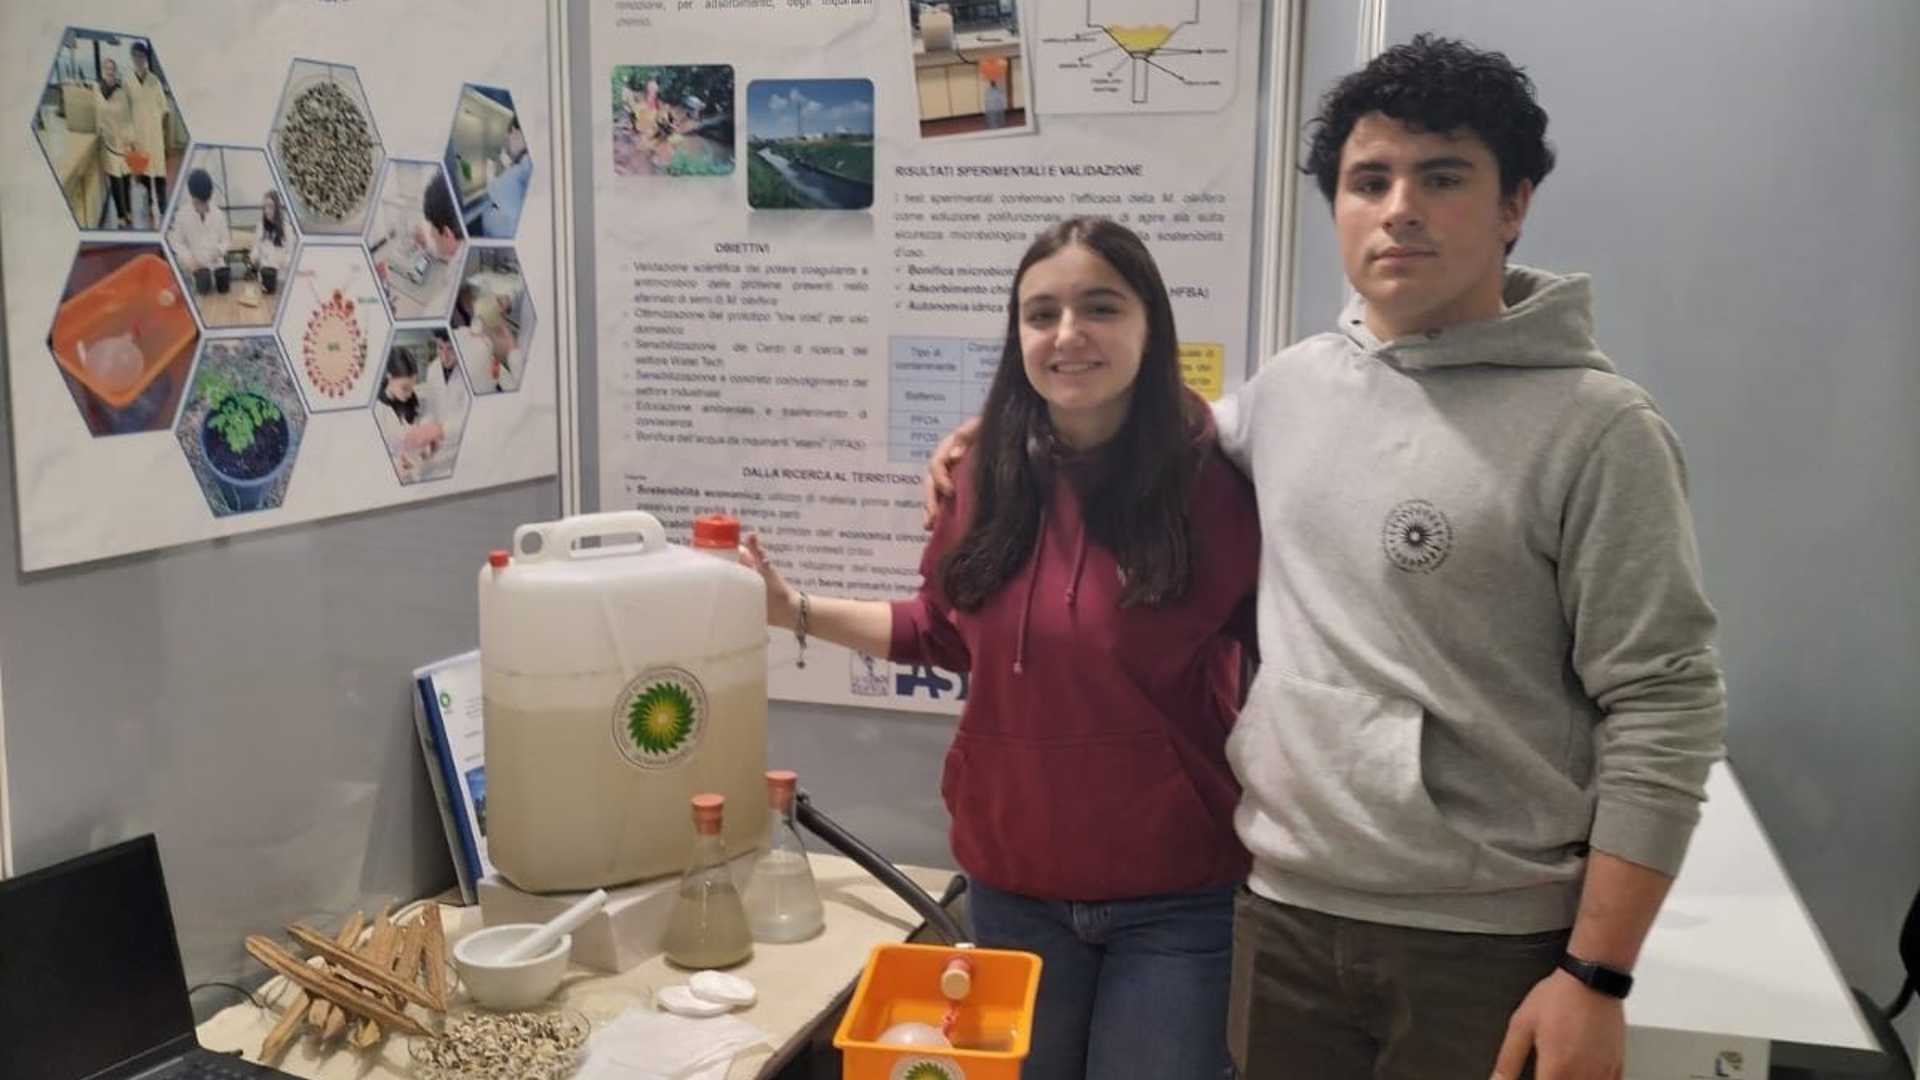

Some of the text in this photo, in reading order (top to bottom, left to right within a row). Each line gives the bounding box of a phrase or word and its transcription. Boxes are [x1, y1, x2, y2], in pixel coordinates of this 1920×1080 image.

[895, 165, 1143, 177] RISULTATI SPERIMENTALI E VALIDAZIONE
[714, 243, 771, 254] OBIETTIVI
[742, 466, 921, 486] DALLA RICERCA AL TERRITORIO
